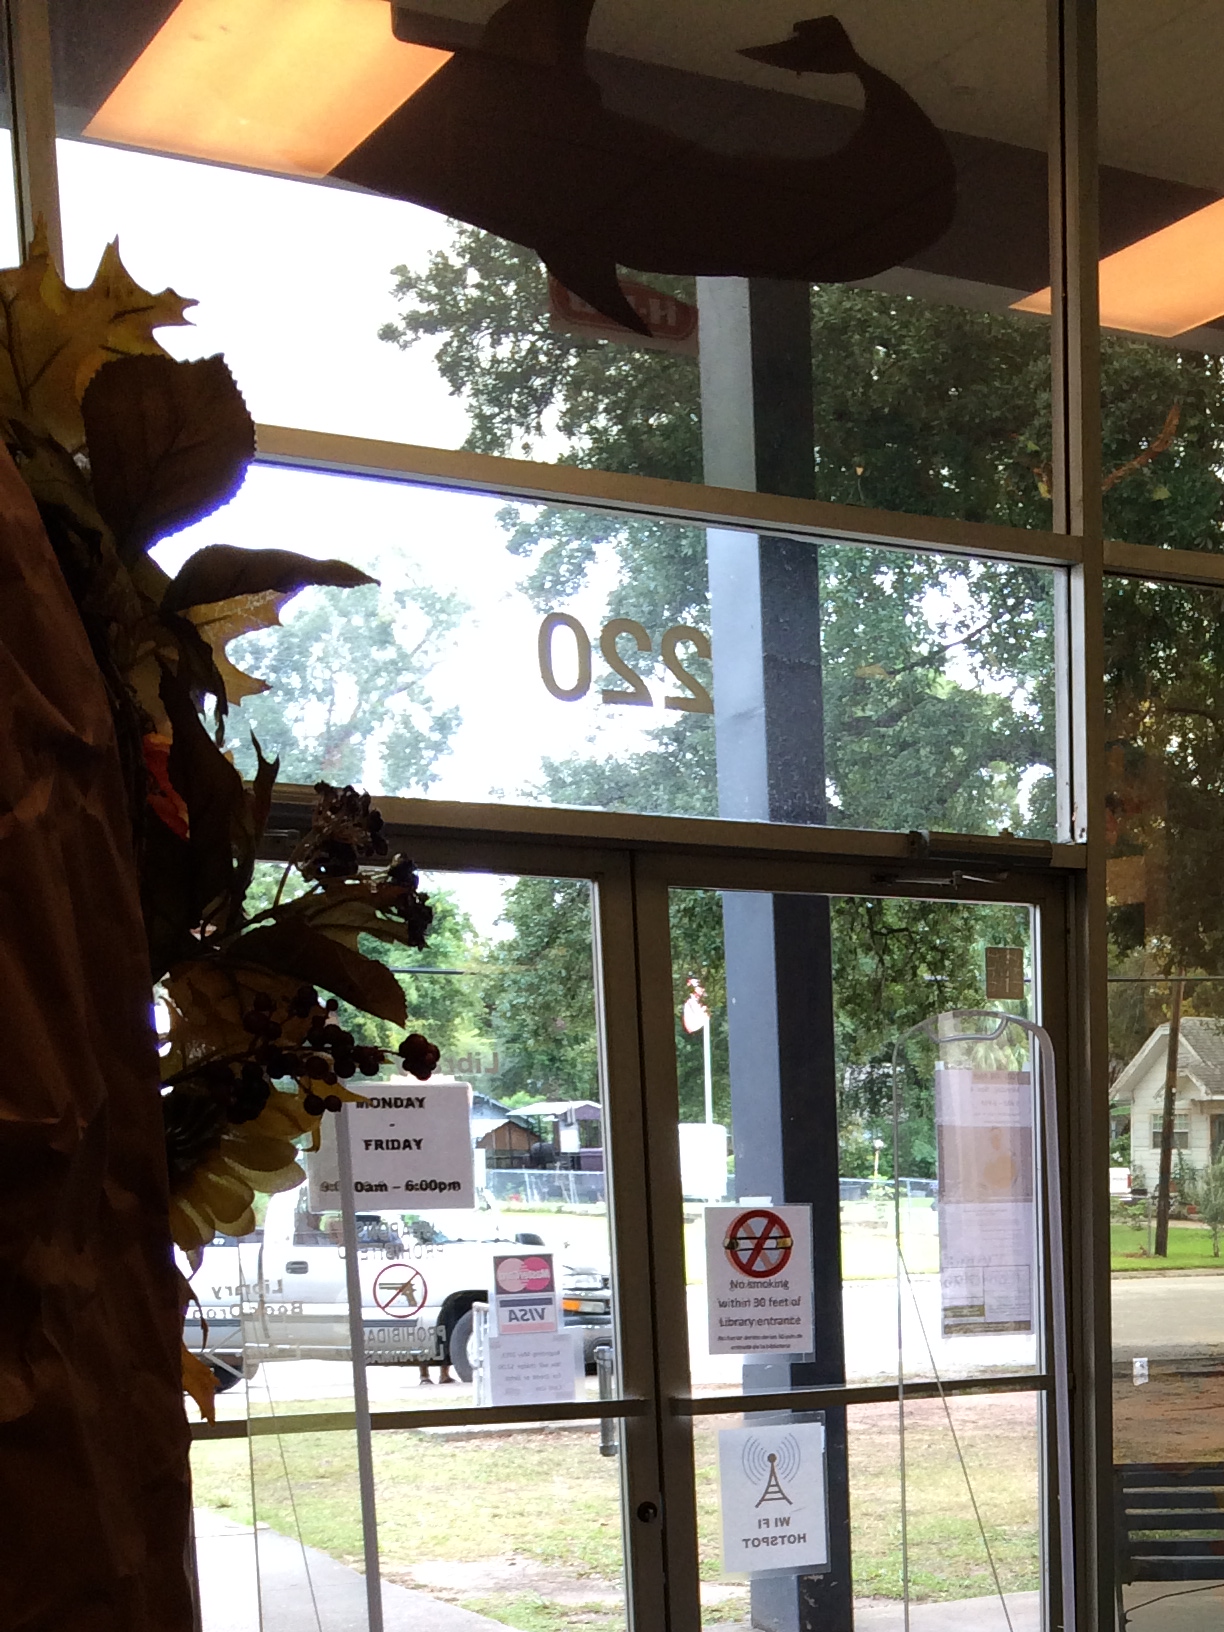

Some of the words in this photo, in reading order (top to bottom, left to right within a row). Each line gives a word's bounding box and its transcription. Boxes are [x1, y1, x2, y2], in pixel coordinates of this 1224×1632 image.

[362, 1137, 424, 1151] FRIDAY
[404, 1179, 462, 1194] 6:00pm
[729, 1279, 745, 1290] No
[747, 1279, 790, 1291] smoking
[717, 1297, 751, 1308] within
[768, 1297, 789, 1307] feet
[791, 1295, 802, 1307] of
[719, 1317, 756, 1328] Library
[757, 1316, 802, 1327] entrance
